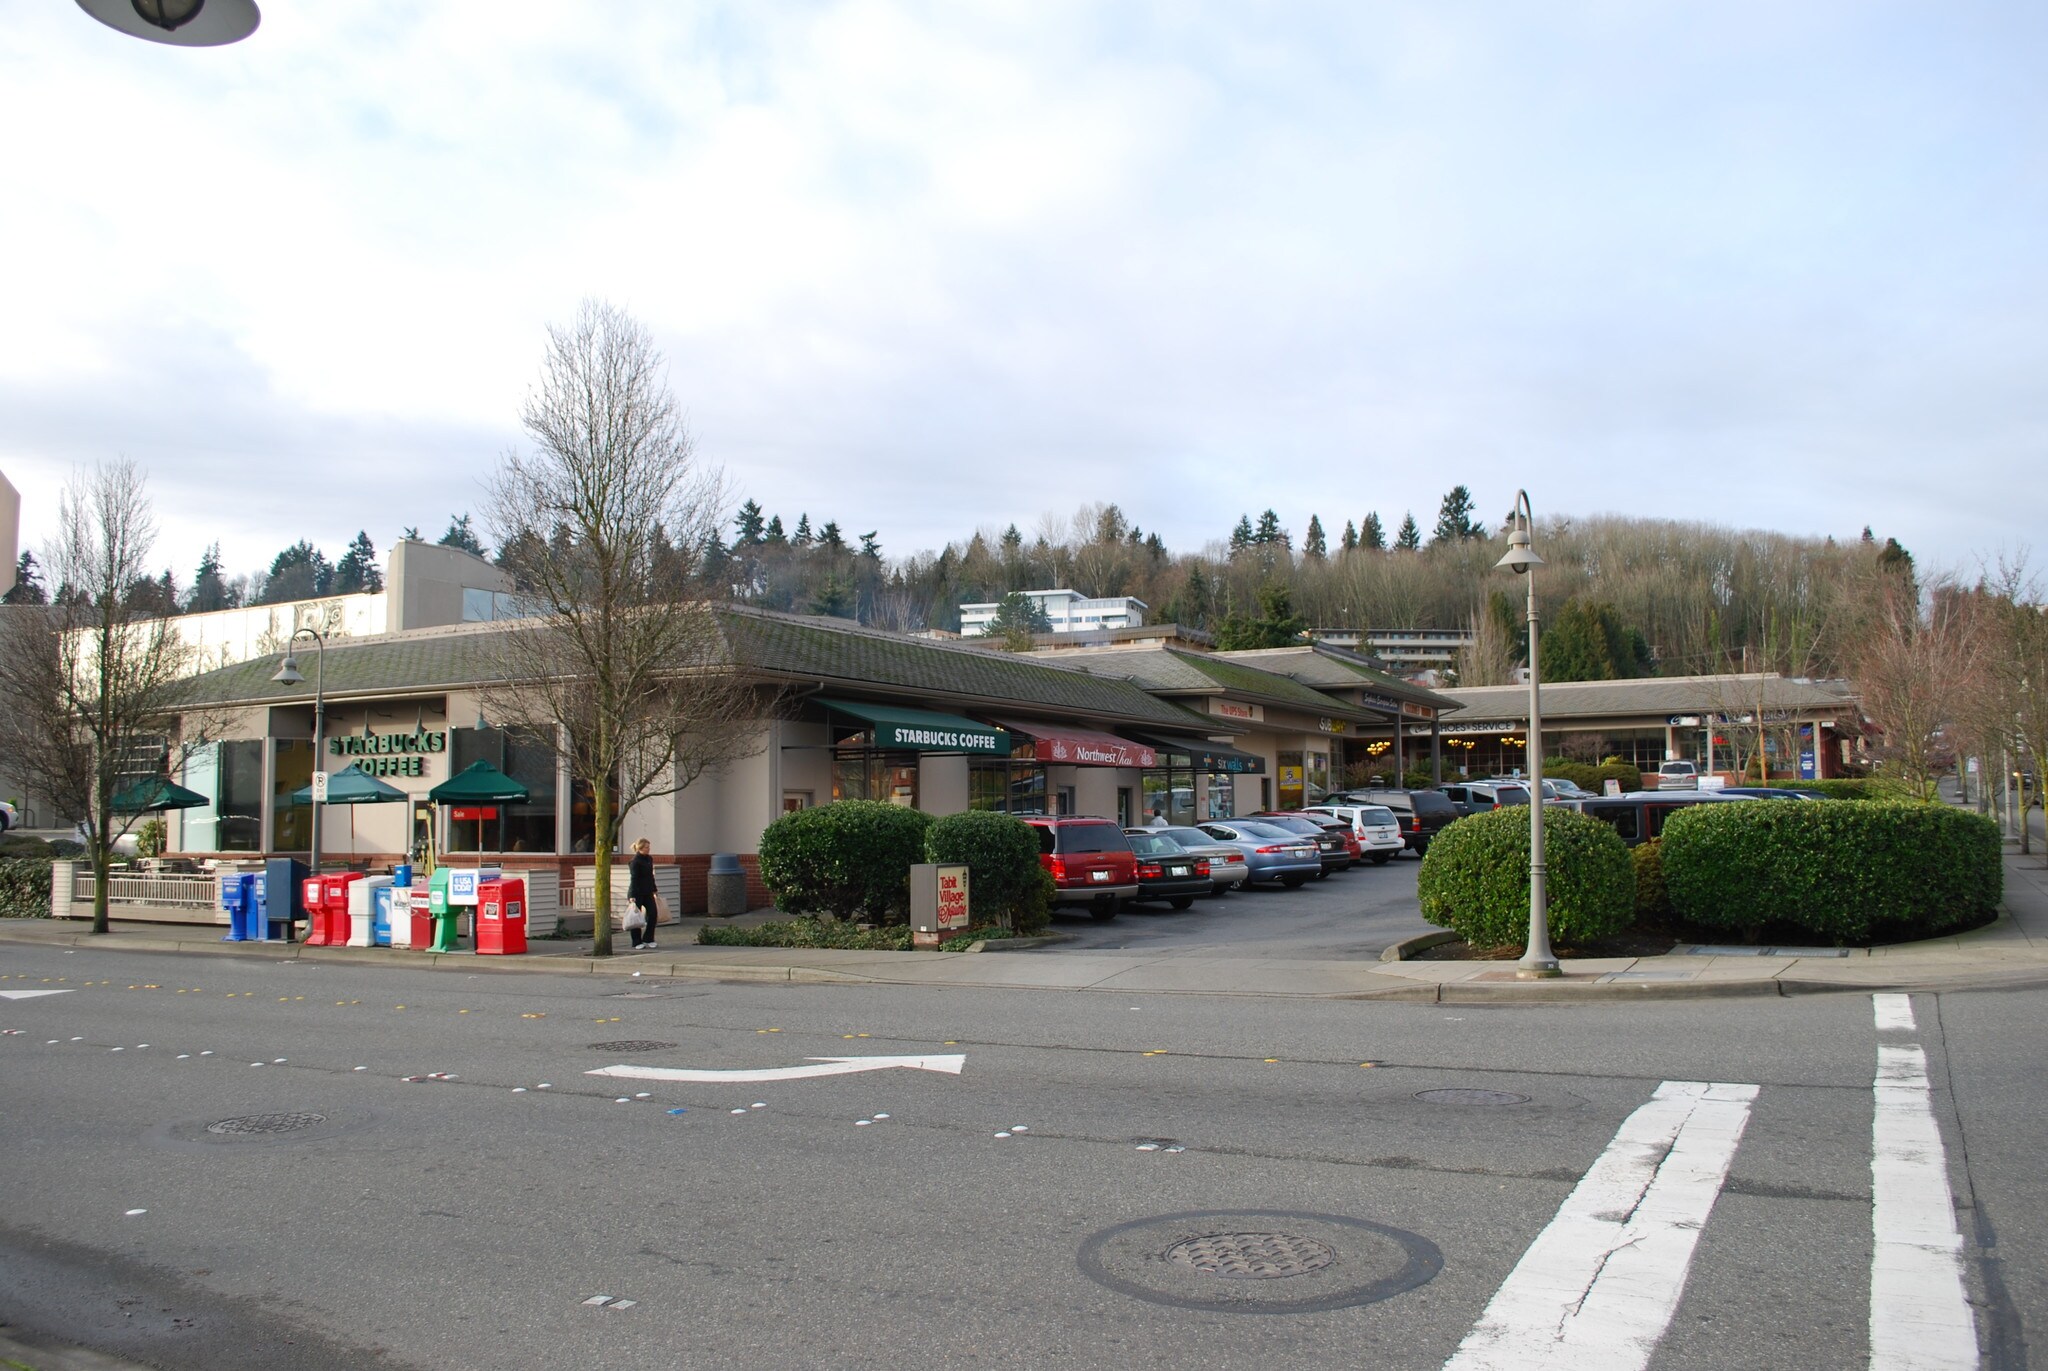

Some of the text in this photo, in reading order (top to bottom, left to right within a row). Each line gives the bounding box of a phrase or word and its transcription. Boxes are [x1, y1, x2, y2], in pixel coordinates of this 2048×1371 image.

[1229, 705, 1238, 716] UPS
[1238, 707, 1248, 718] Store
[1472, 720, 1511, 731] SERVICE
[329, 731, 446, 756] STARBUCKS
[895, 728, 995, 749] STARBUCKS COFFEE
[1076, 747, 1116, 763] Northwest
[1217, 756, 1243, 771] six walls
[453, 810, 465, 818] Sale
[940, 876, 957, 889] Tabit
[939, 890, 965, 905] Village
